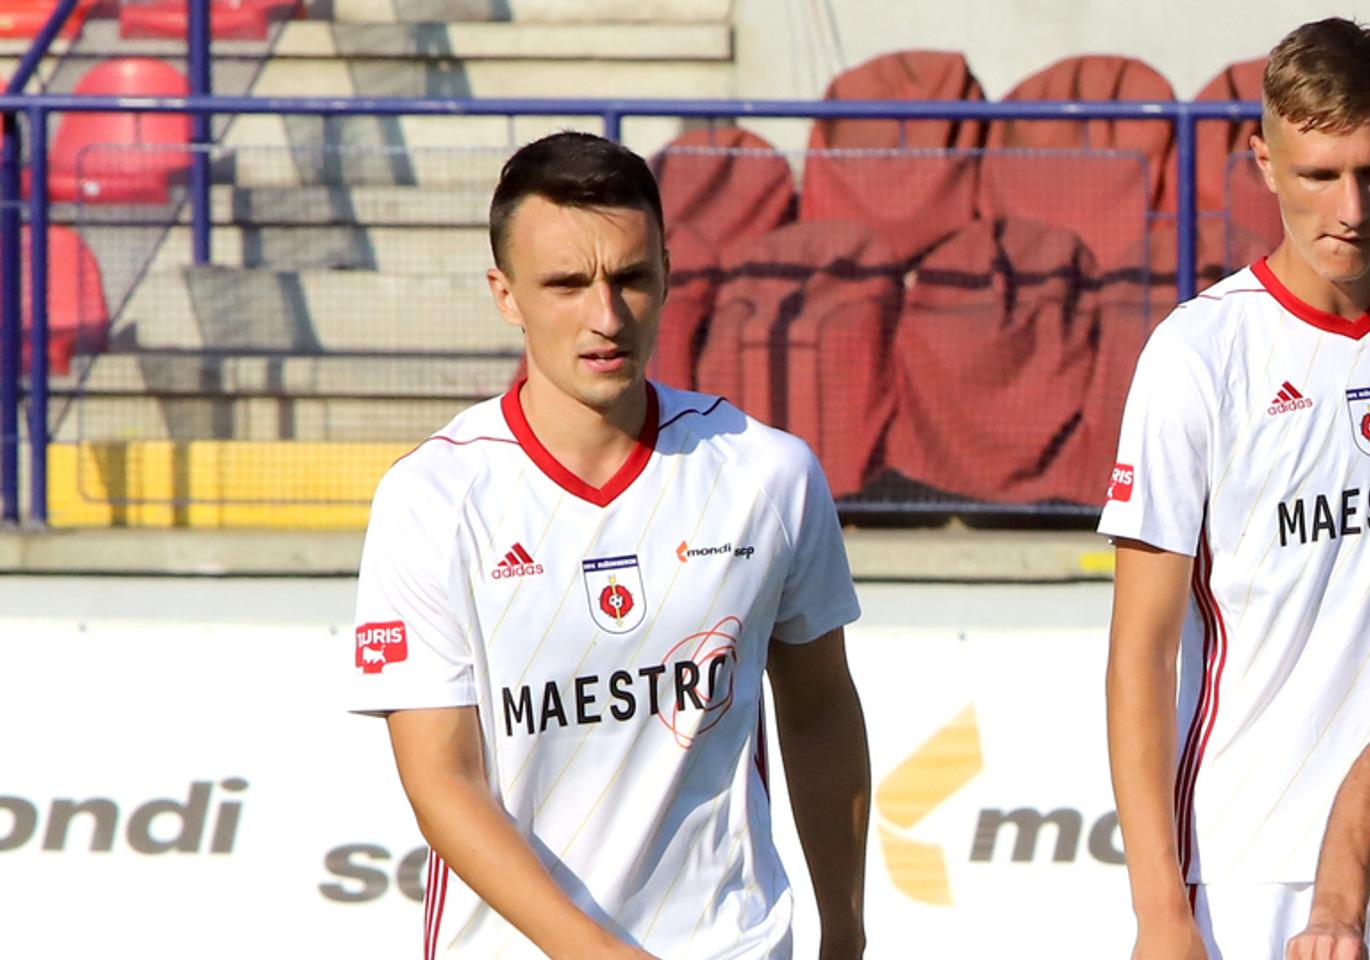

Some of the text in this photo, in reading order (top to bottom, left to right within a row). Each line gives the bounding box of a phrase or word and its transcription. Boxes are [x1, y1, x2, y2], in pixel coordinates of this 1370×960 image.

[1267, 397, 1313, 416] adidas
[687, 543, 732, 558] mondi
[491, 563, 544, 580] adidas
